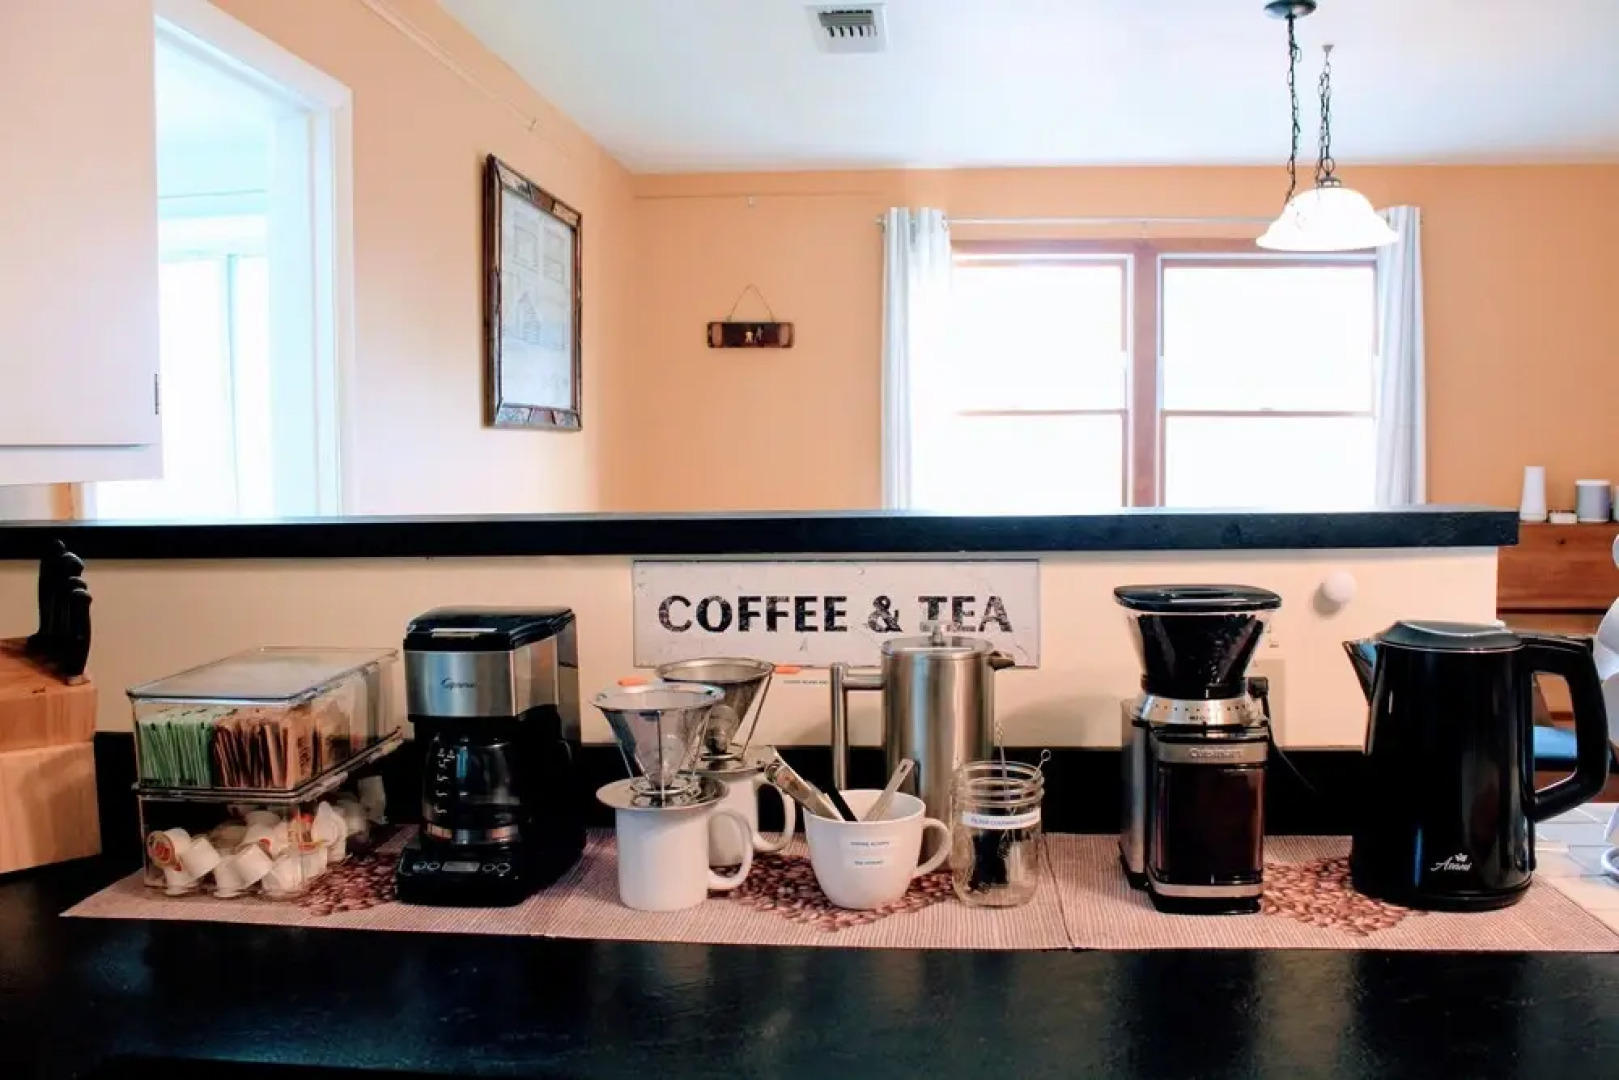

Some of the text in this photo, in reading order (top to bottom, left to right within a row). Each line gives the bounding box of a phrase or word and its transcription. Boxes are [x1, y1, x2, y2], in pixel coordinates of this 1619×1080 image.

[658, 595, 1013, 633] COFFEE & TEA
